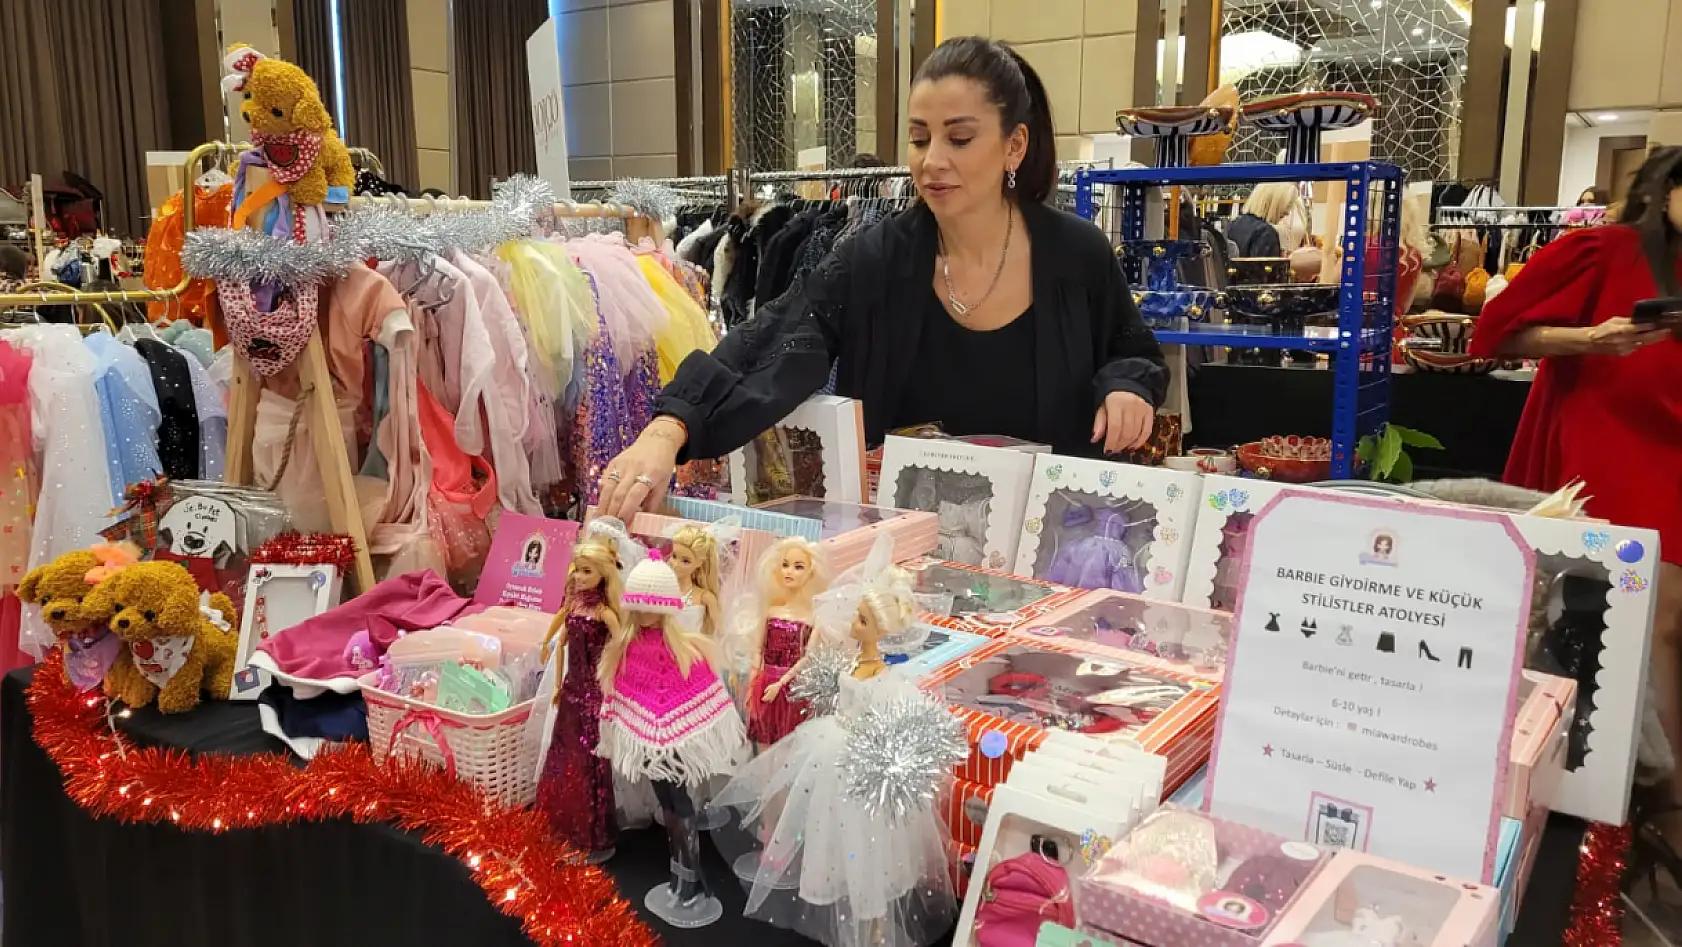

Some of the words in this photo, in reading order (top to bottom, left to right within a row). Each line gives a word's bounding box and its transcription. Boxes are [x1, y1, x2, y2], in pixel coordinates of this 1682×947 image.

[1276, 566, 1326, 586] BARBIE
[1329, 573, 1402, 597] GİYDİRME
[1405, 586, 1425, 600] VE
[1428, 589, 1484, 610] KÜÇÜK
[1301, 592, 1375, 616] STİLİSTLER
[1377, 606, 1447, 628] ATOLYESİ
[1347, 671, 1372, 684] getir
[1380, 677, 1416, 691] tasarla
[1331, 698, 1355, 711] 6-10
[1357, 704, 1374, 718] yaş
[1273, 706, 1314, 722] Detaylar
[1316, 715, 1334, 728] için
[1361, 726, 1439, 751] miawardrobes
[1281, 748, 1314, 764] Tasarla
[1325, 759, 1352, 774] Süsle
[1363, 768, 1394, 784] Defile
[1398, 776, 1417, 791] Yap
